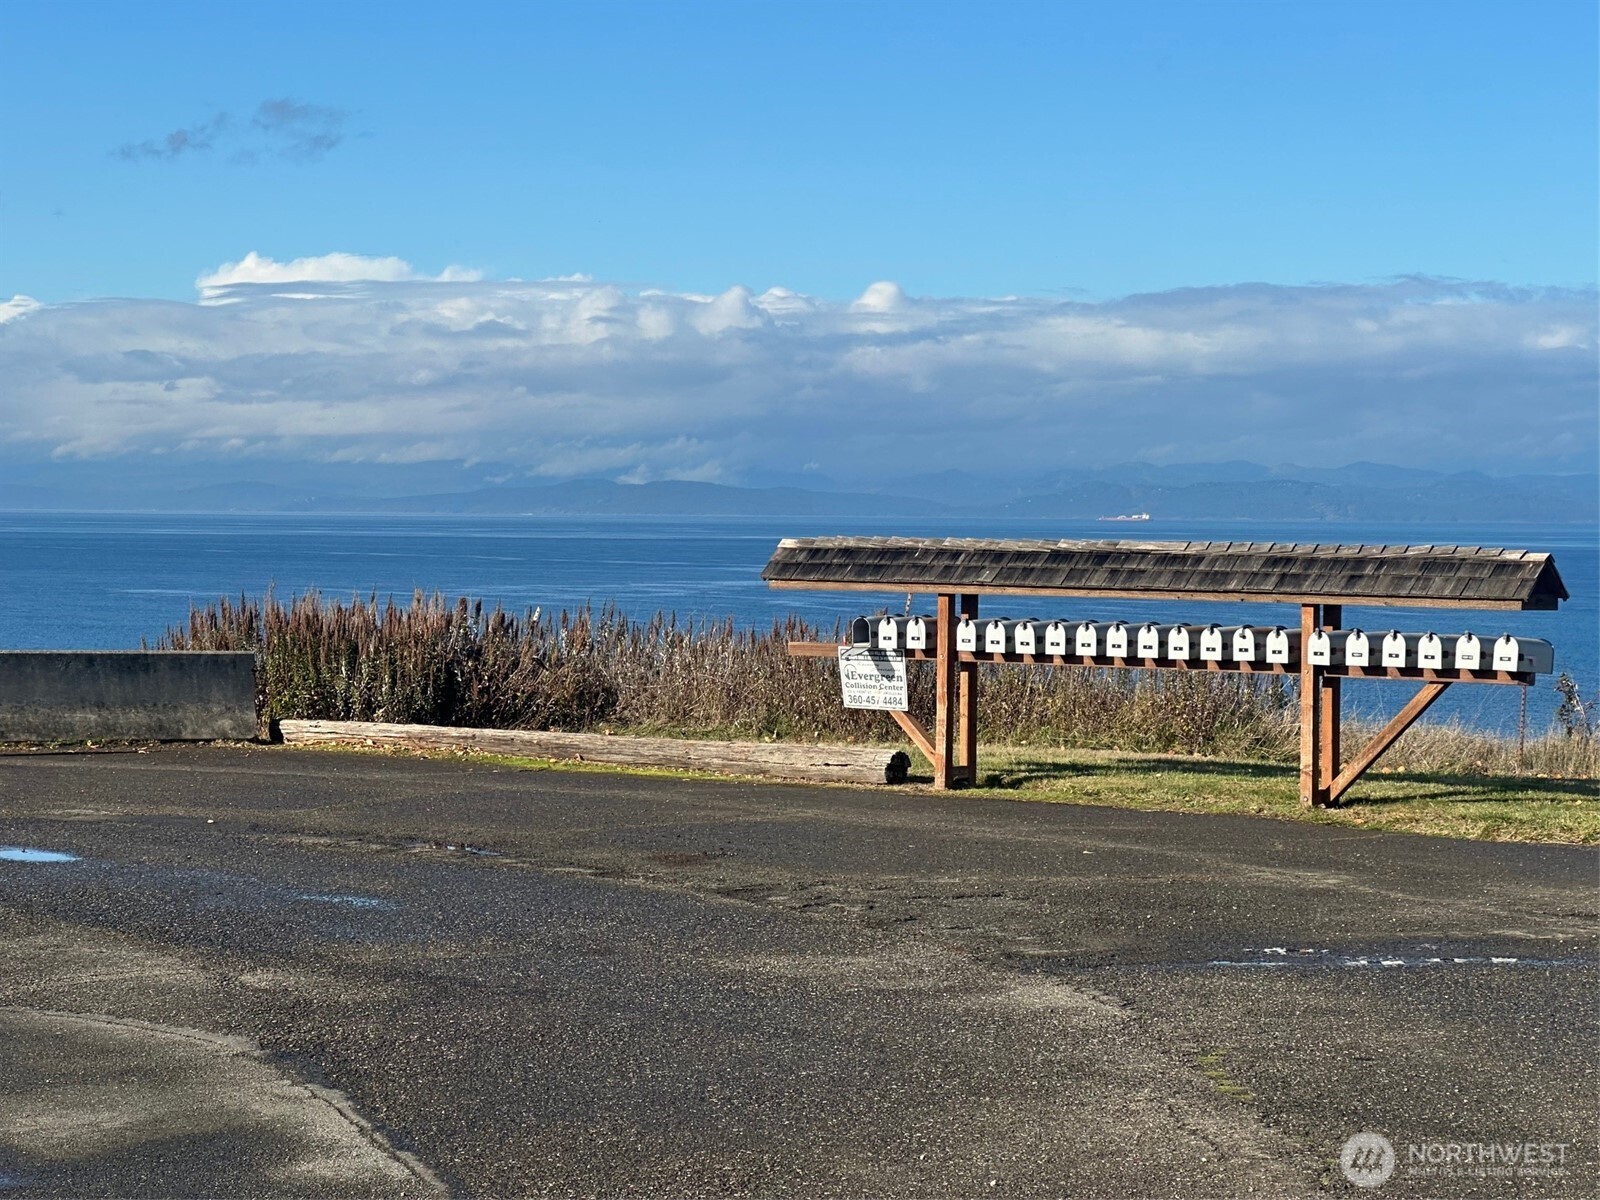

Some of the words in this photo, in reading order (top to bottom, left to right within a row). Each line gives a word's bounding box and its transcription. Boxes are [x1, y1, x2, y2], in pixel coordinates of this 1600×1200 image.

[850, 670, 903, 683] Evergreen
[845, 682, 878, 690] Collision
[879, 683, 904, 691] Center
